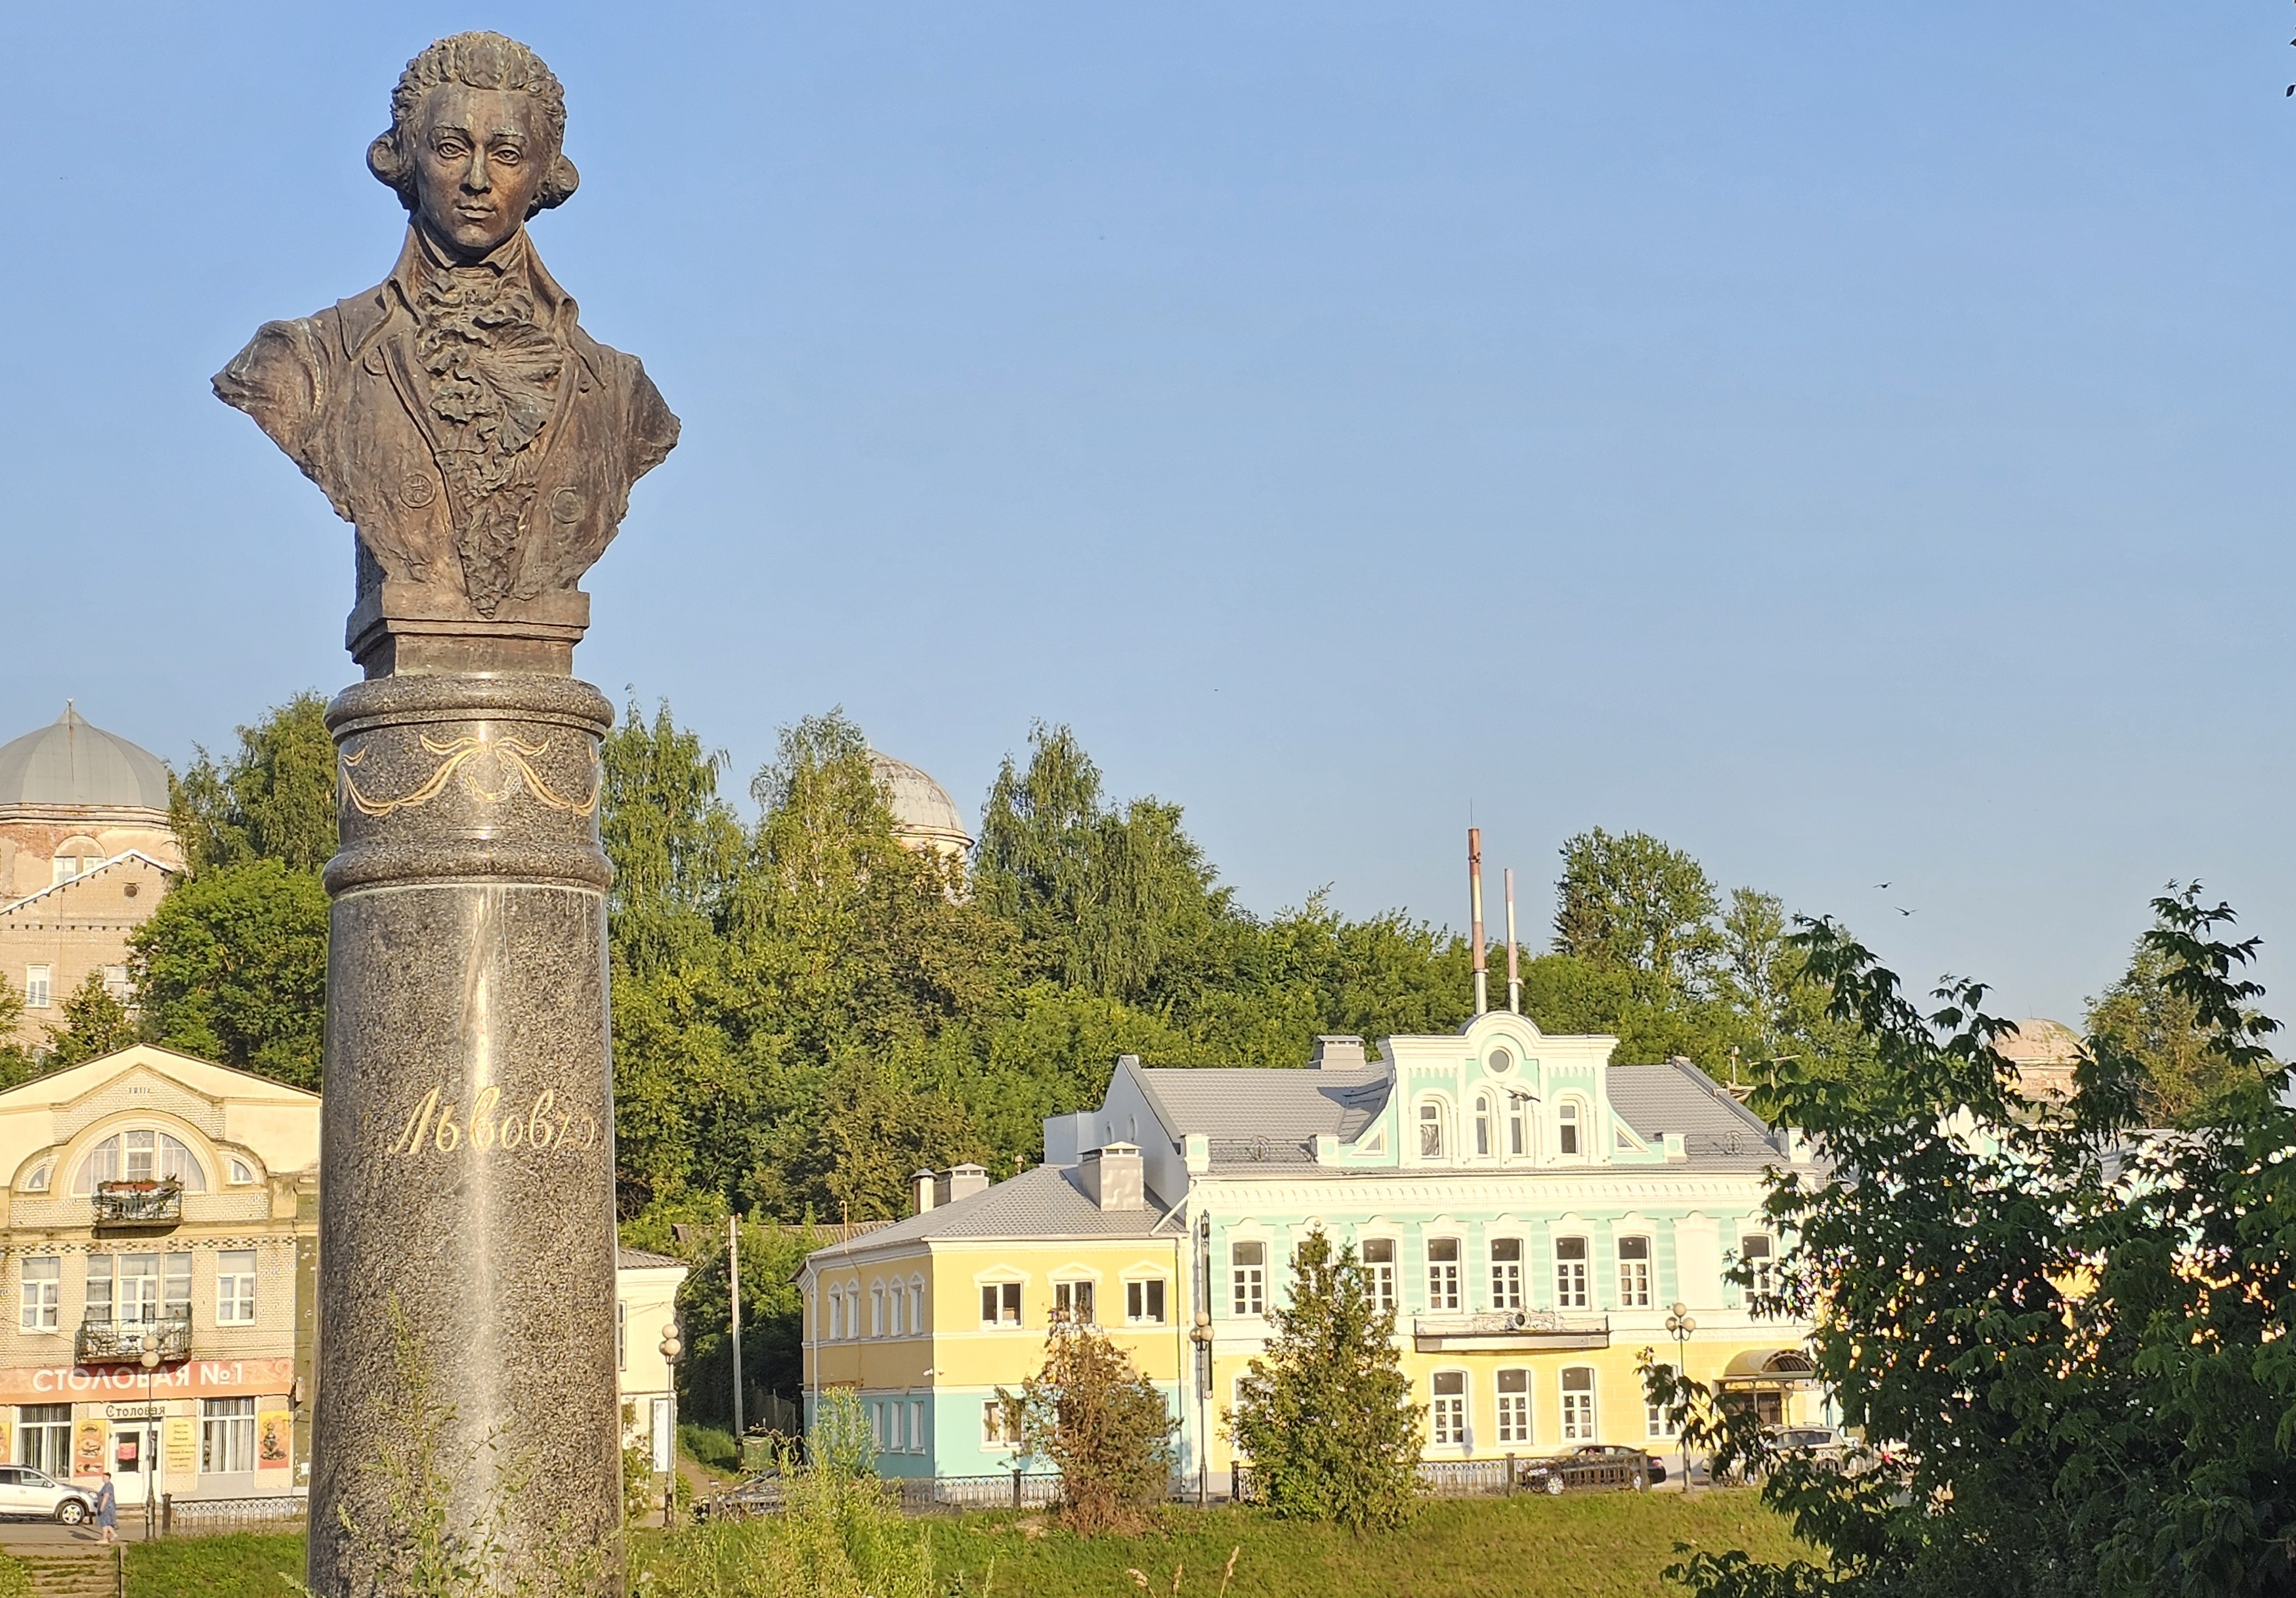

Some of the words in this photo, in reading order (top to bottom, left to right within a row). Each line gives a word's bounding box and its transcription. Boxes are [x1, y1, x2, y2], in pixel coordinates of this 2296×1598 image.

[33, 1365, 190, 1392] СТОЛОВАЯ
[200, 1362, 243, 1385] №1
[106, 1405, 165, 1418] Столовая
